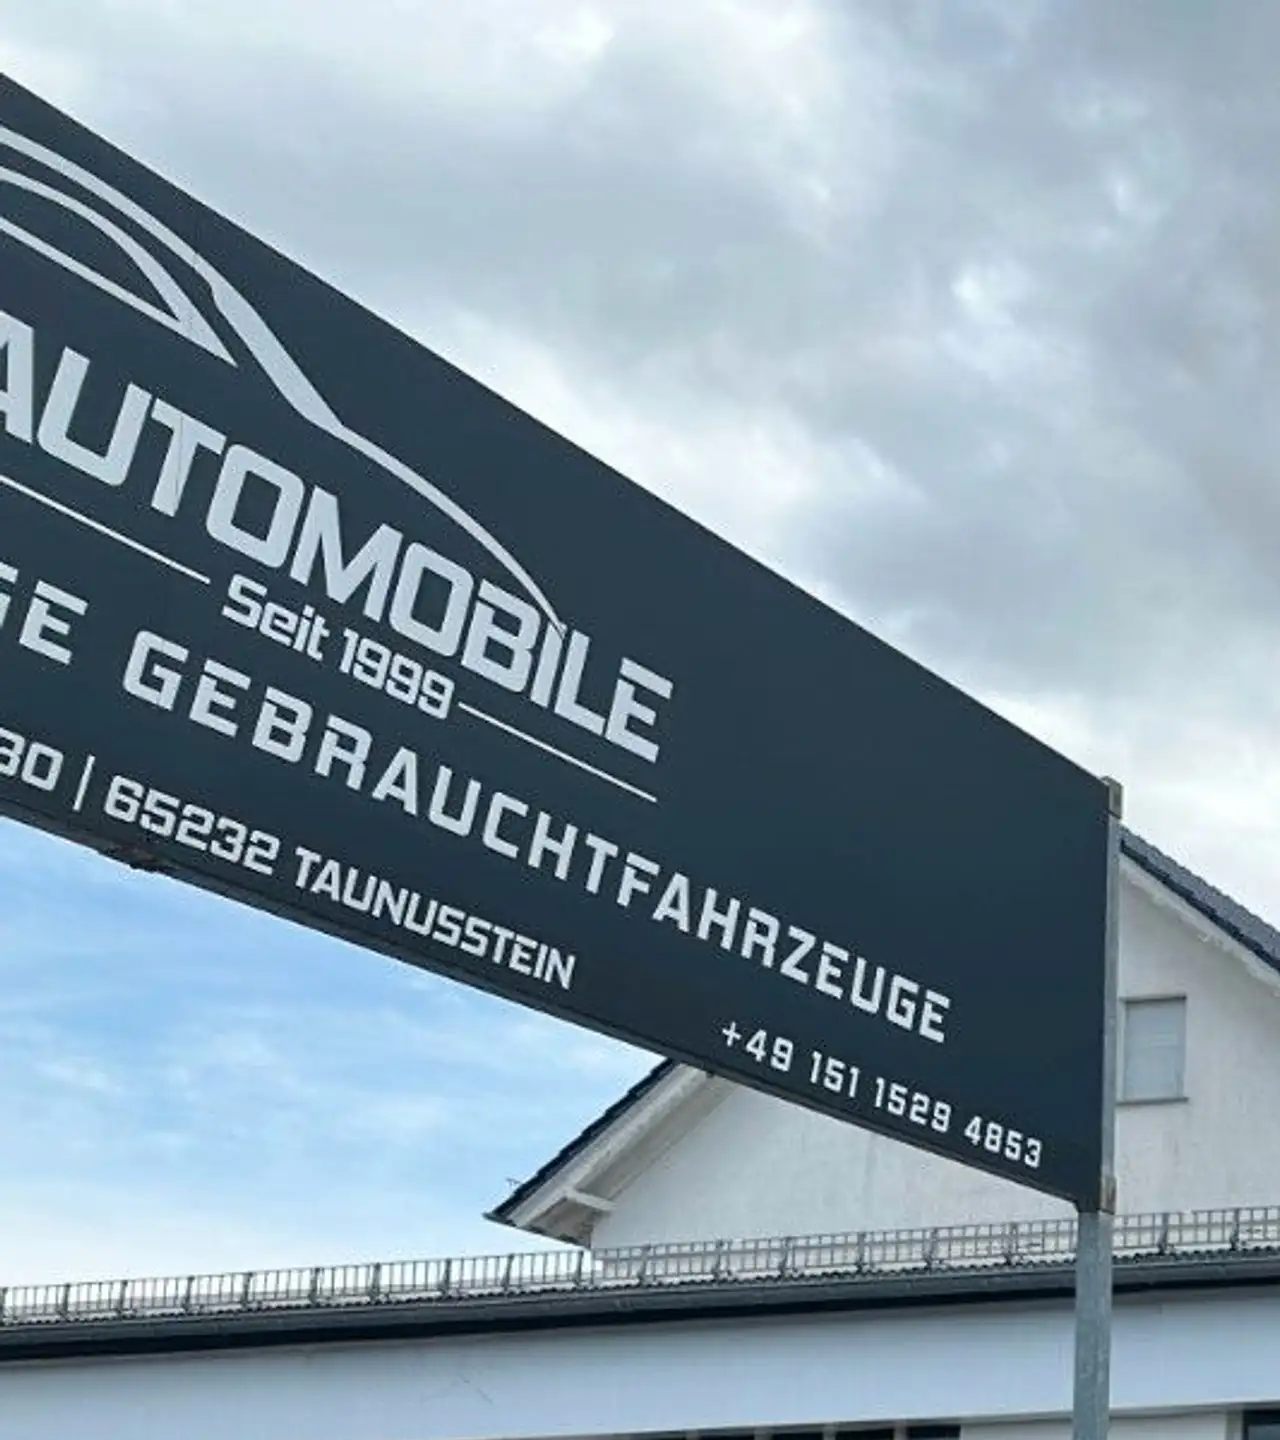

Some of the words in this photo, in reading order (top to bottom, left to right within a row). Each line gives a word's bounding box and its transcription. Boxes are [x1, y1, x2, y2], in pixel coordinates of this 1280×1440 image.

[221, 573, 330, 661] Seit
[339, 627, 455, 721] 1999
[104, 775, 281, 876] 65232
[295, 846, 579, 991] TAUNUSSTEIN
[122, 630, 951, 1044] GEBRAUCHTFAHRZEUGE
[722, 1021, 794, 1072] +49
[810, 1050, 860, 1098] 151
[874, 1076, 952, 1133] 1529
[964, 1115, 1043, 1168] 4853
